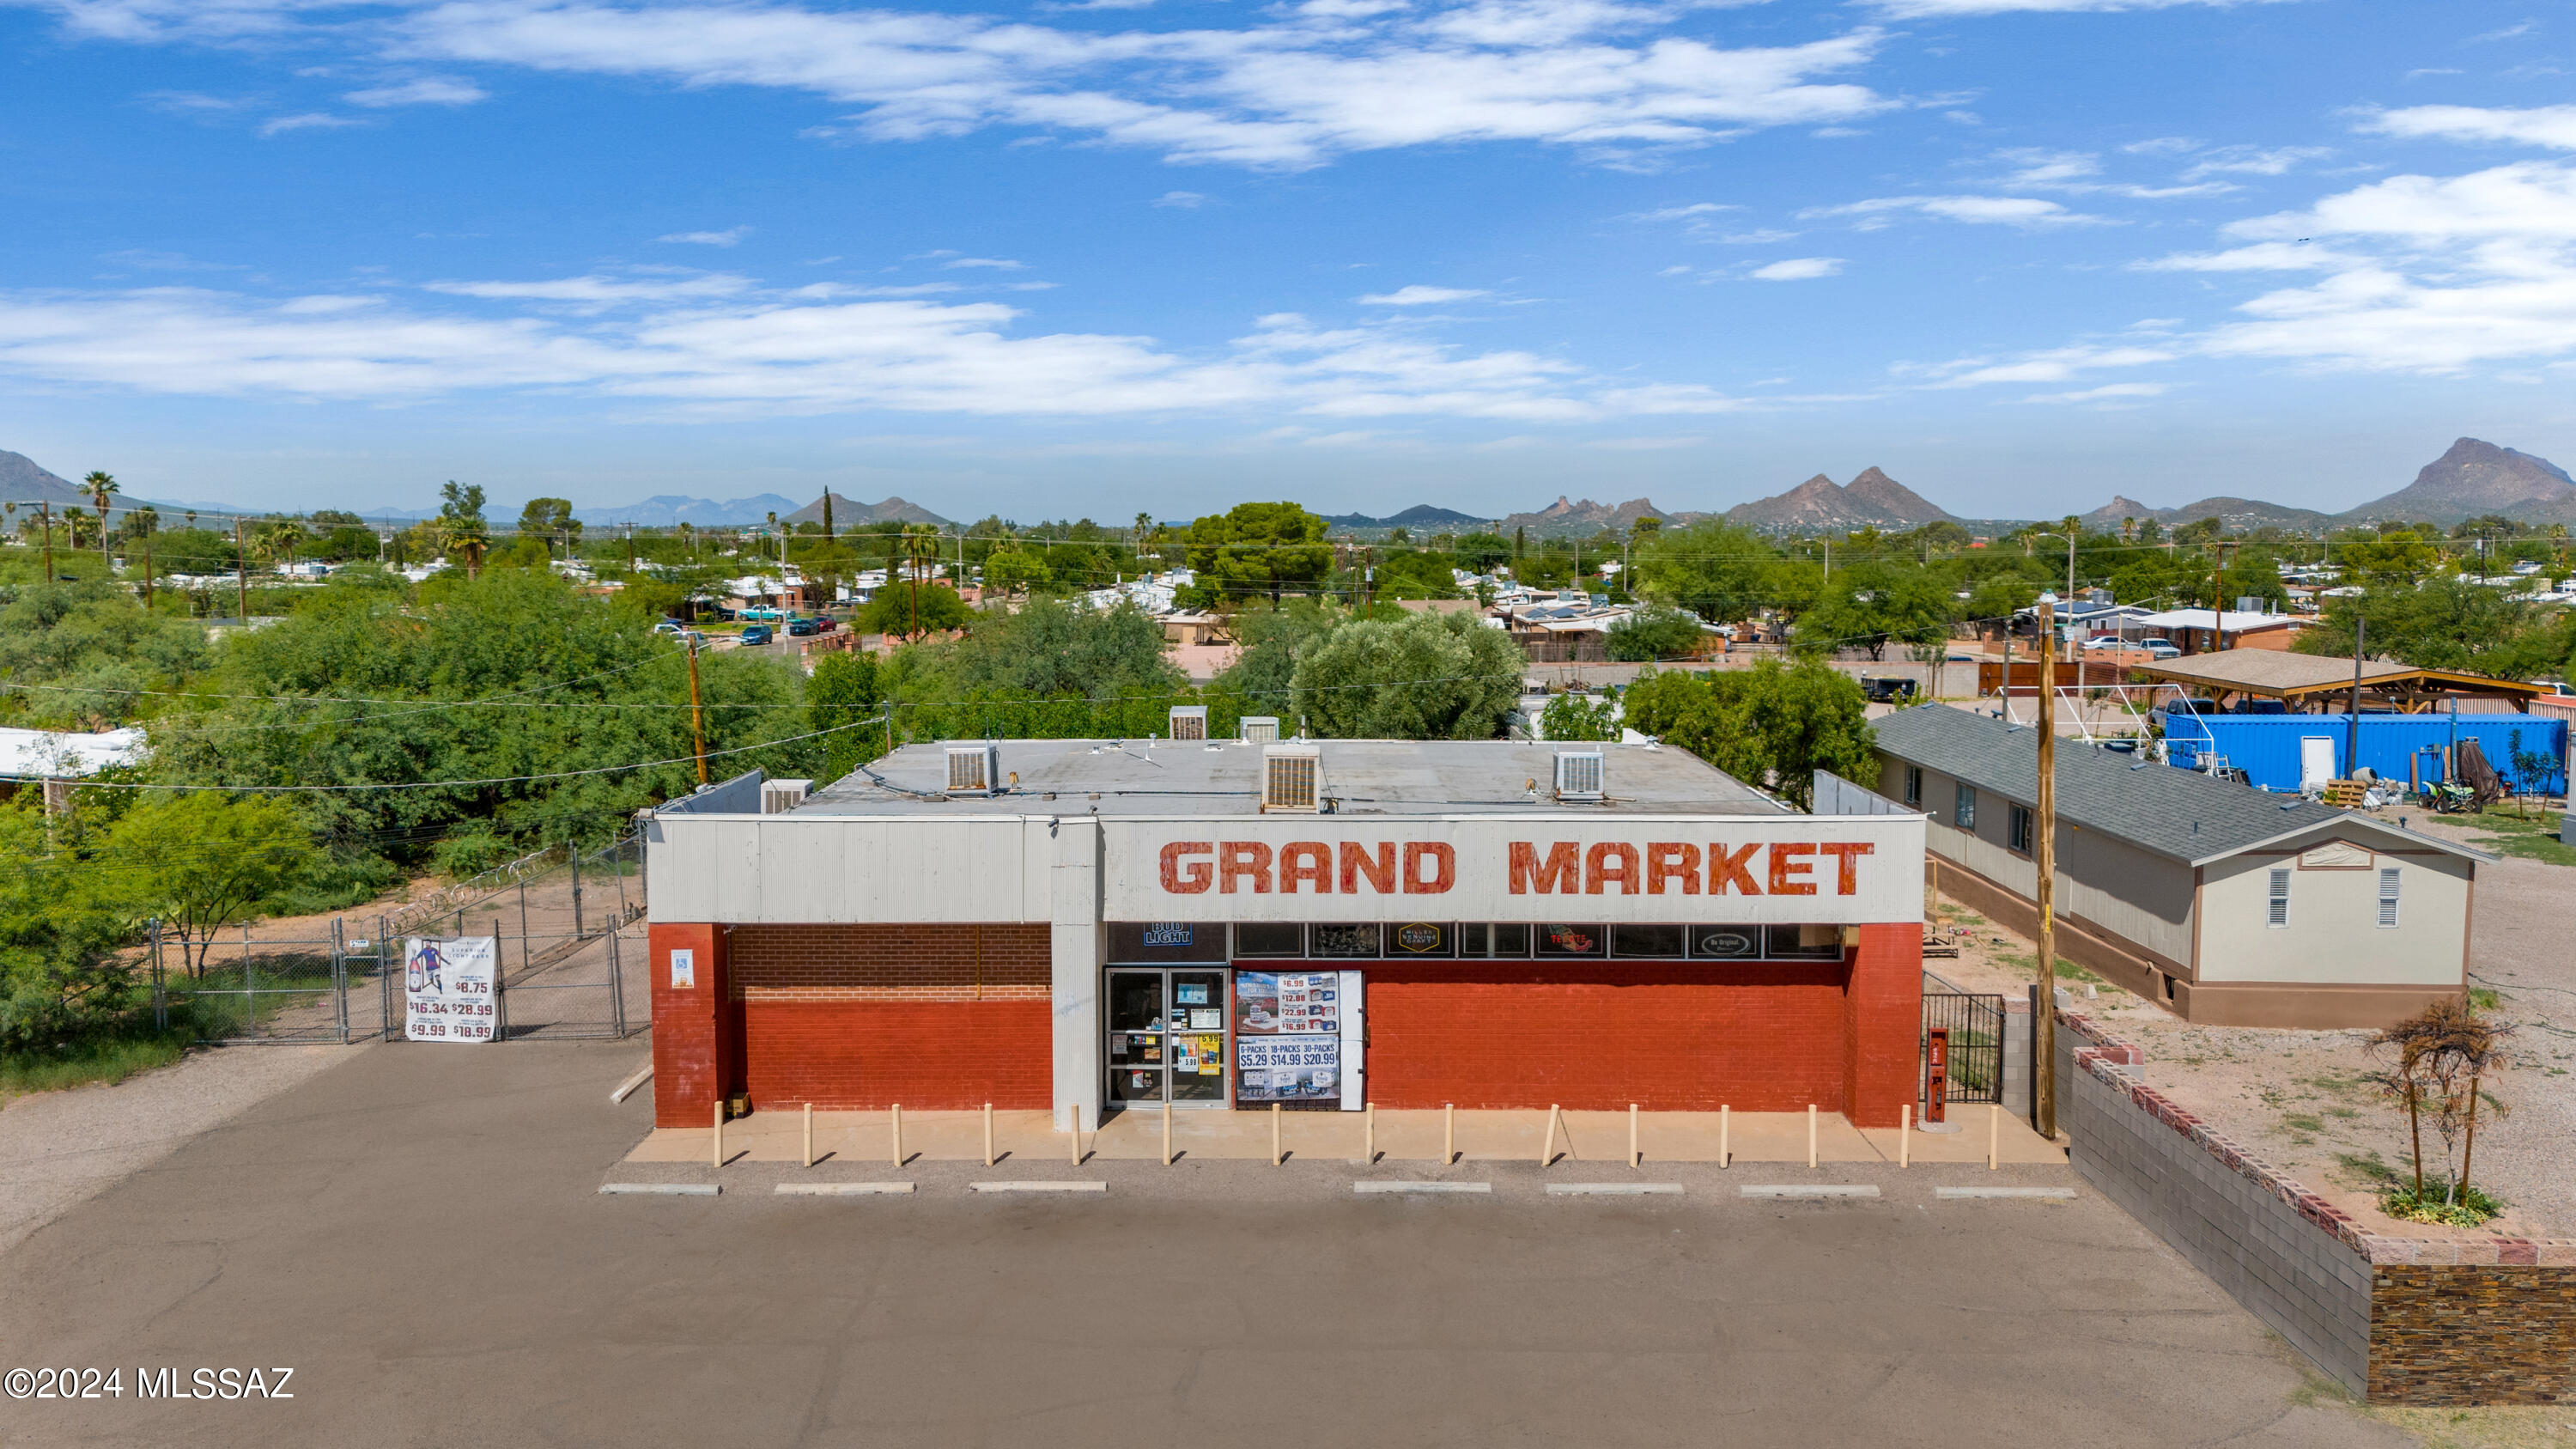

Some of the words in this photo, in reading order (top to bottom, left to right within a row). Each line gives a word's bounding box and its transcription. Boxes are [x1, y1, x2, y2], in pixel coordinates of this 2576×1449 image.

[1159, 841, 1455, 894] GRAND
[1509, 841, 1875, 896] MARKET
[1152, 922, 1184, 932] BUD
[1146, 932, 1190, 943] LIGHT
[455, 982, 488, 994] $8.75
[409, 1002, 447, 1014] $16.34
[452, 1002, 493, 1016] $28.99
[411, 1024, 446, 1037] $9.99
[453, 1026, 491, 1038] $18.99
[1241, 1045, 1267, 1054] 6-PACKS
[1271, 1044, 1301, 1053] 18-PACKS
[1303, 1044, 1335, 1053] 30-PACKS
[1241, 1054, 1267, 1067] $5.29
[1271, 1053, 1301, 1066] $14.99
[1303, 1052, 1335, 1065] $20.99
